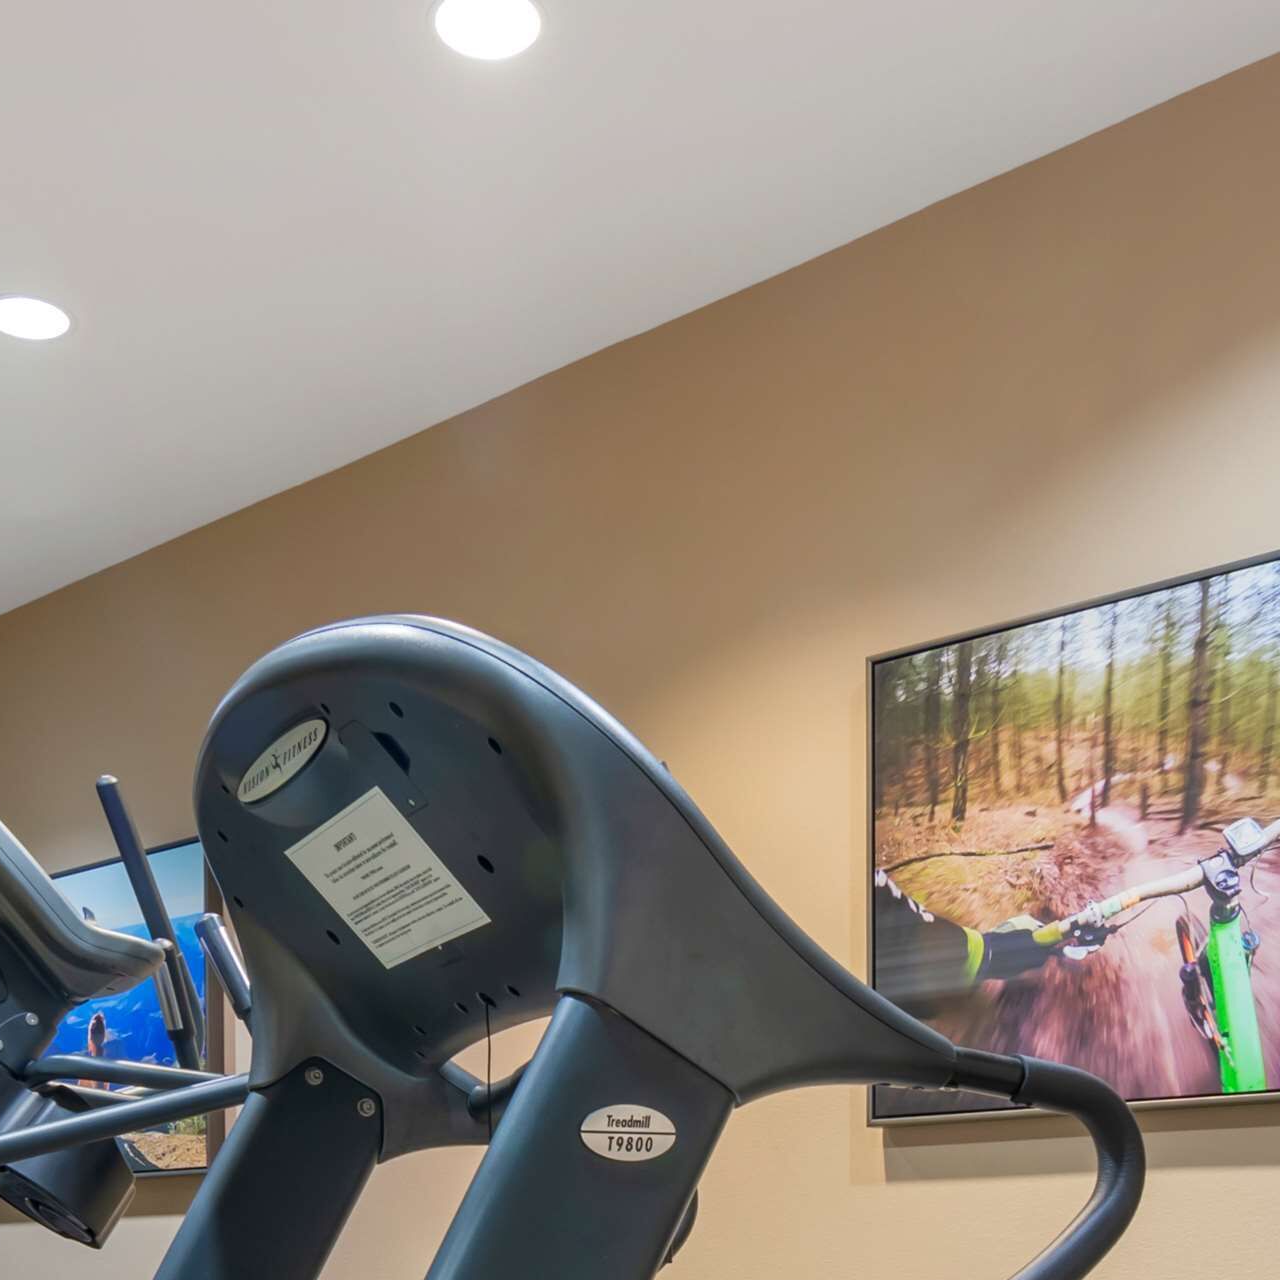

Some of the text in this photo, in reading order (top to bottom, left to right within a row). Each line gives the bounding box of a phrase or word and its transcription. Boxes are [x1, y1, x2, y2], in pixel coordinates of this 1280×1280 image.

[242, 727, 318, 794] VISION FITNESS
[606, 1114, 651, 1128] Treadmill
[607, 1136, 653, 1152] T9800
